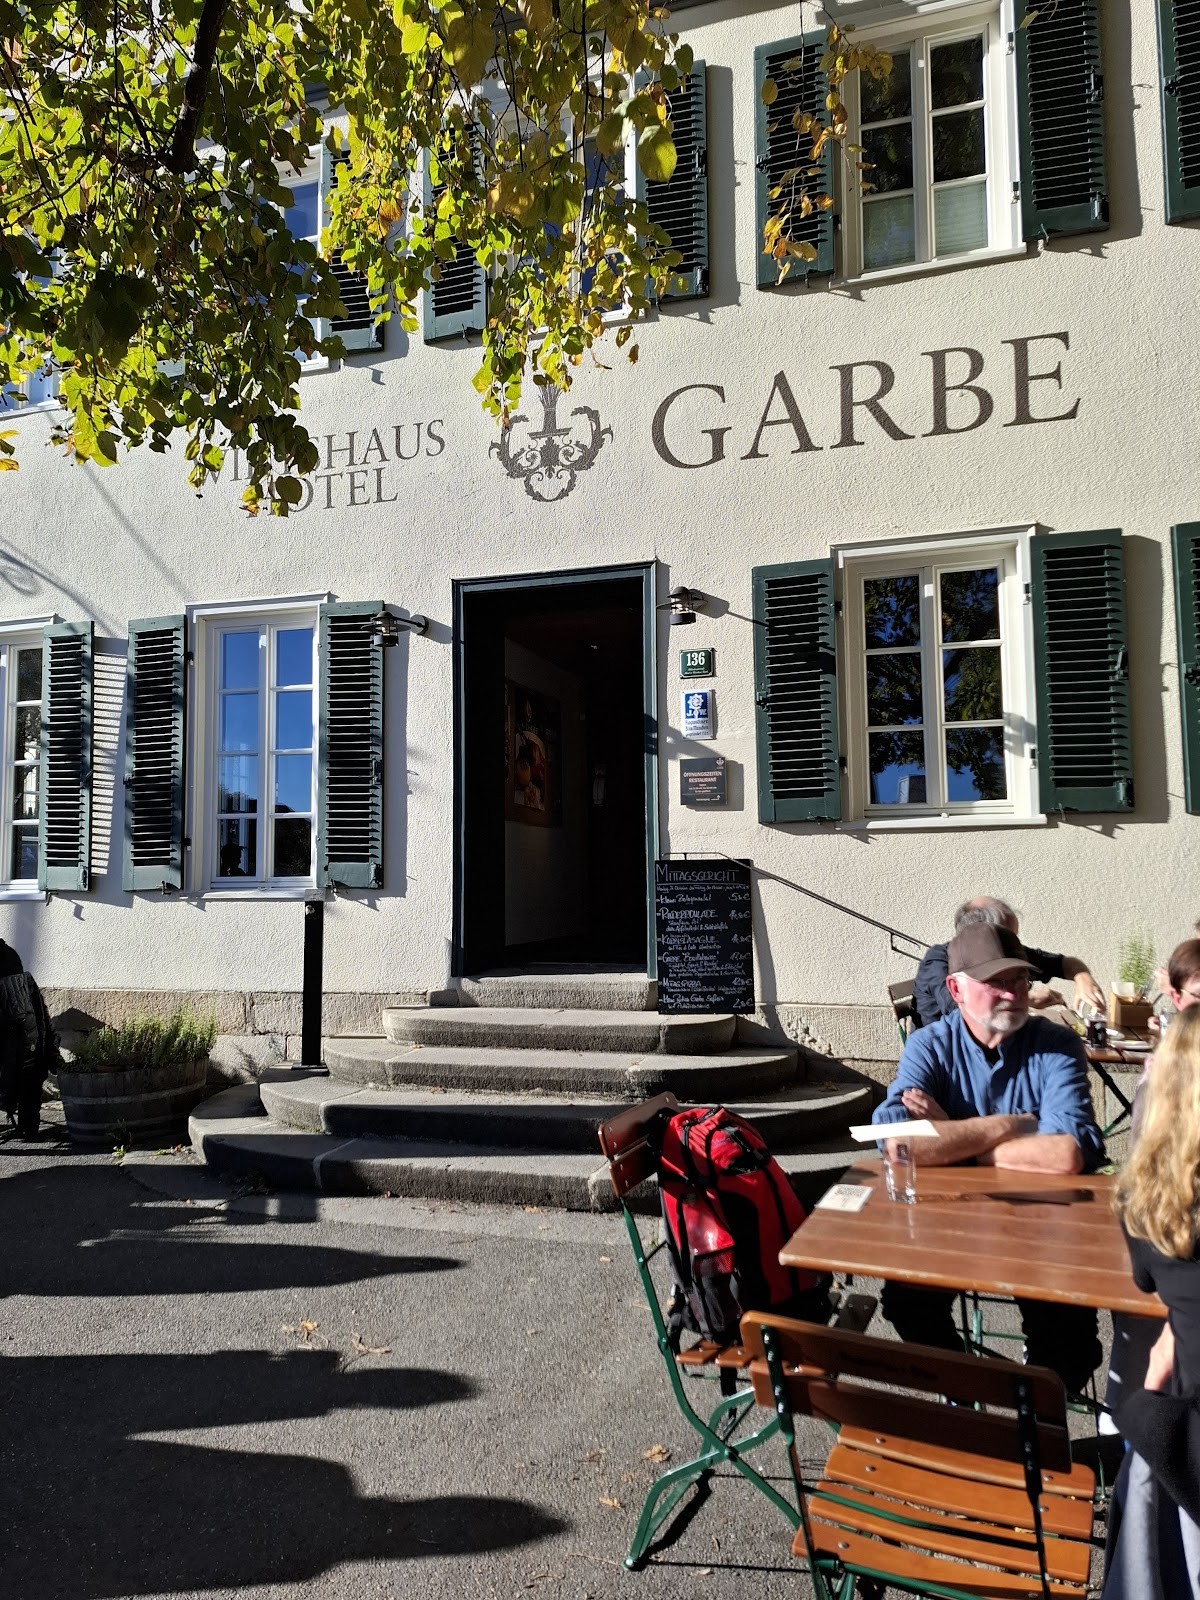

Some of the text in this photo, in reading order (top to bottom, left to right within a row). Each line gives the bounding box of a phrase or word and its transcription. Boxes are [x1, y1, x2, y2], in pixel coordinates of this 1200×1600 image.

[651, 330, 1080, 469] GARBE
[245, 466, 399, 518] OTEL
[686, 651, 706, 667] 136
[656, 863, 739, 882] MITTAGSGERICHT
